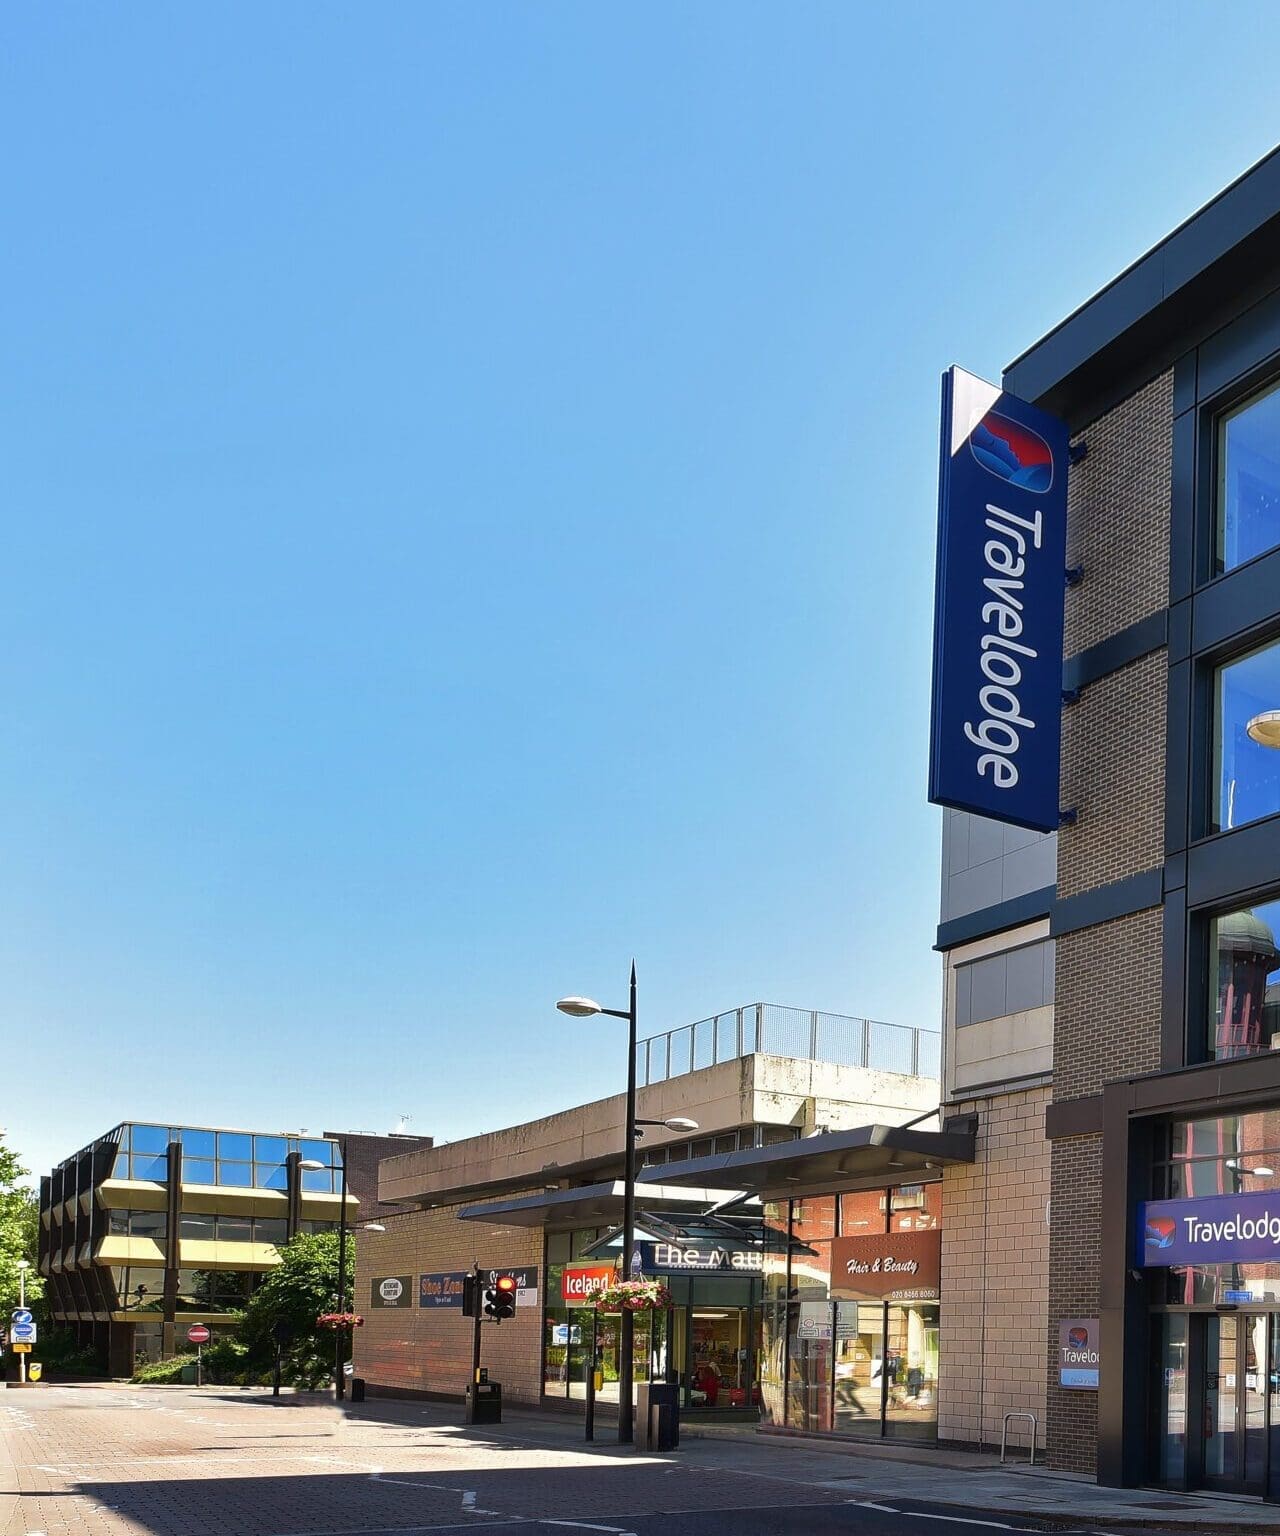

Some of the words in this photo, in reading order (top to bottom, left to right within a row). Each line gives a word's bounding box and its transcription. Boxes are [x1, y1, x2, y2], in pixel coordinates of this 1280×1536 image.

[964, 503, 1042, 789] Travelodge
[648, 1243, 699, 1267] The
[846, 1259, 870, 1275] Hair
[872, 1258, 881, 1273] &
[883, 1257, 918, 1275] Beauty
[566, 1273, 609, 1294] Iceland
[1062, 1347, 1100, 1363] Travelo
